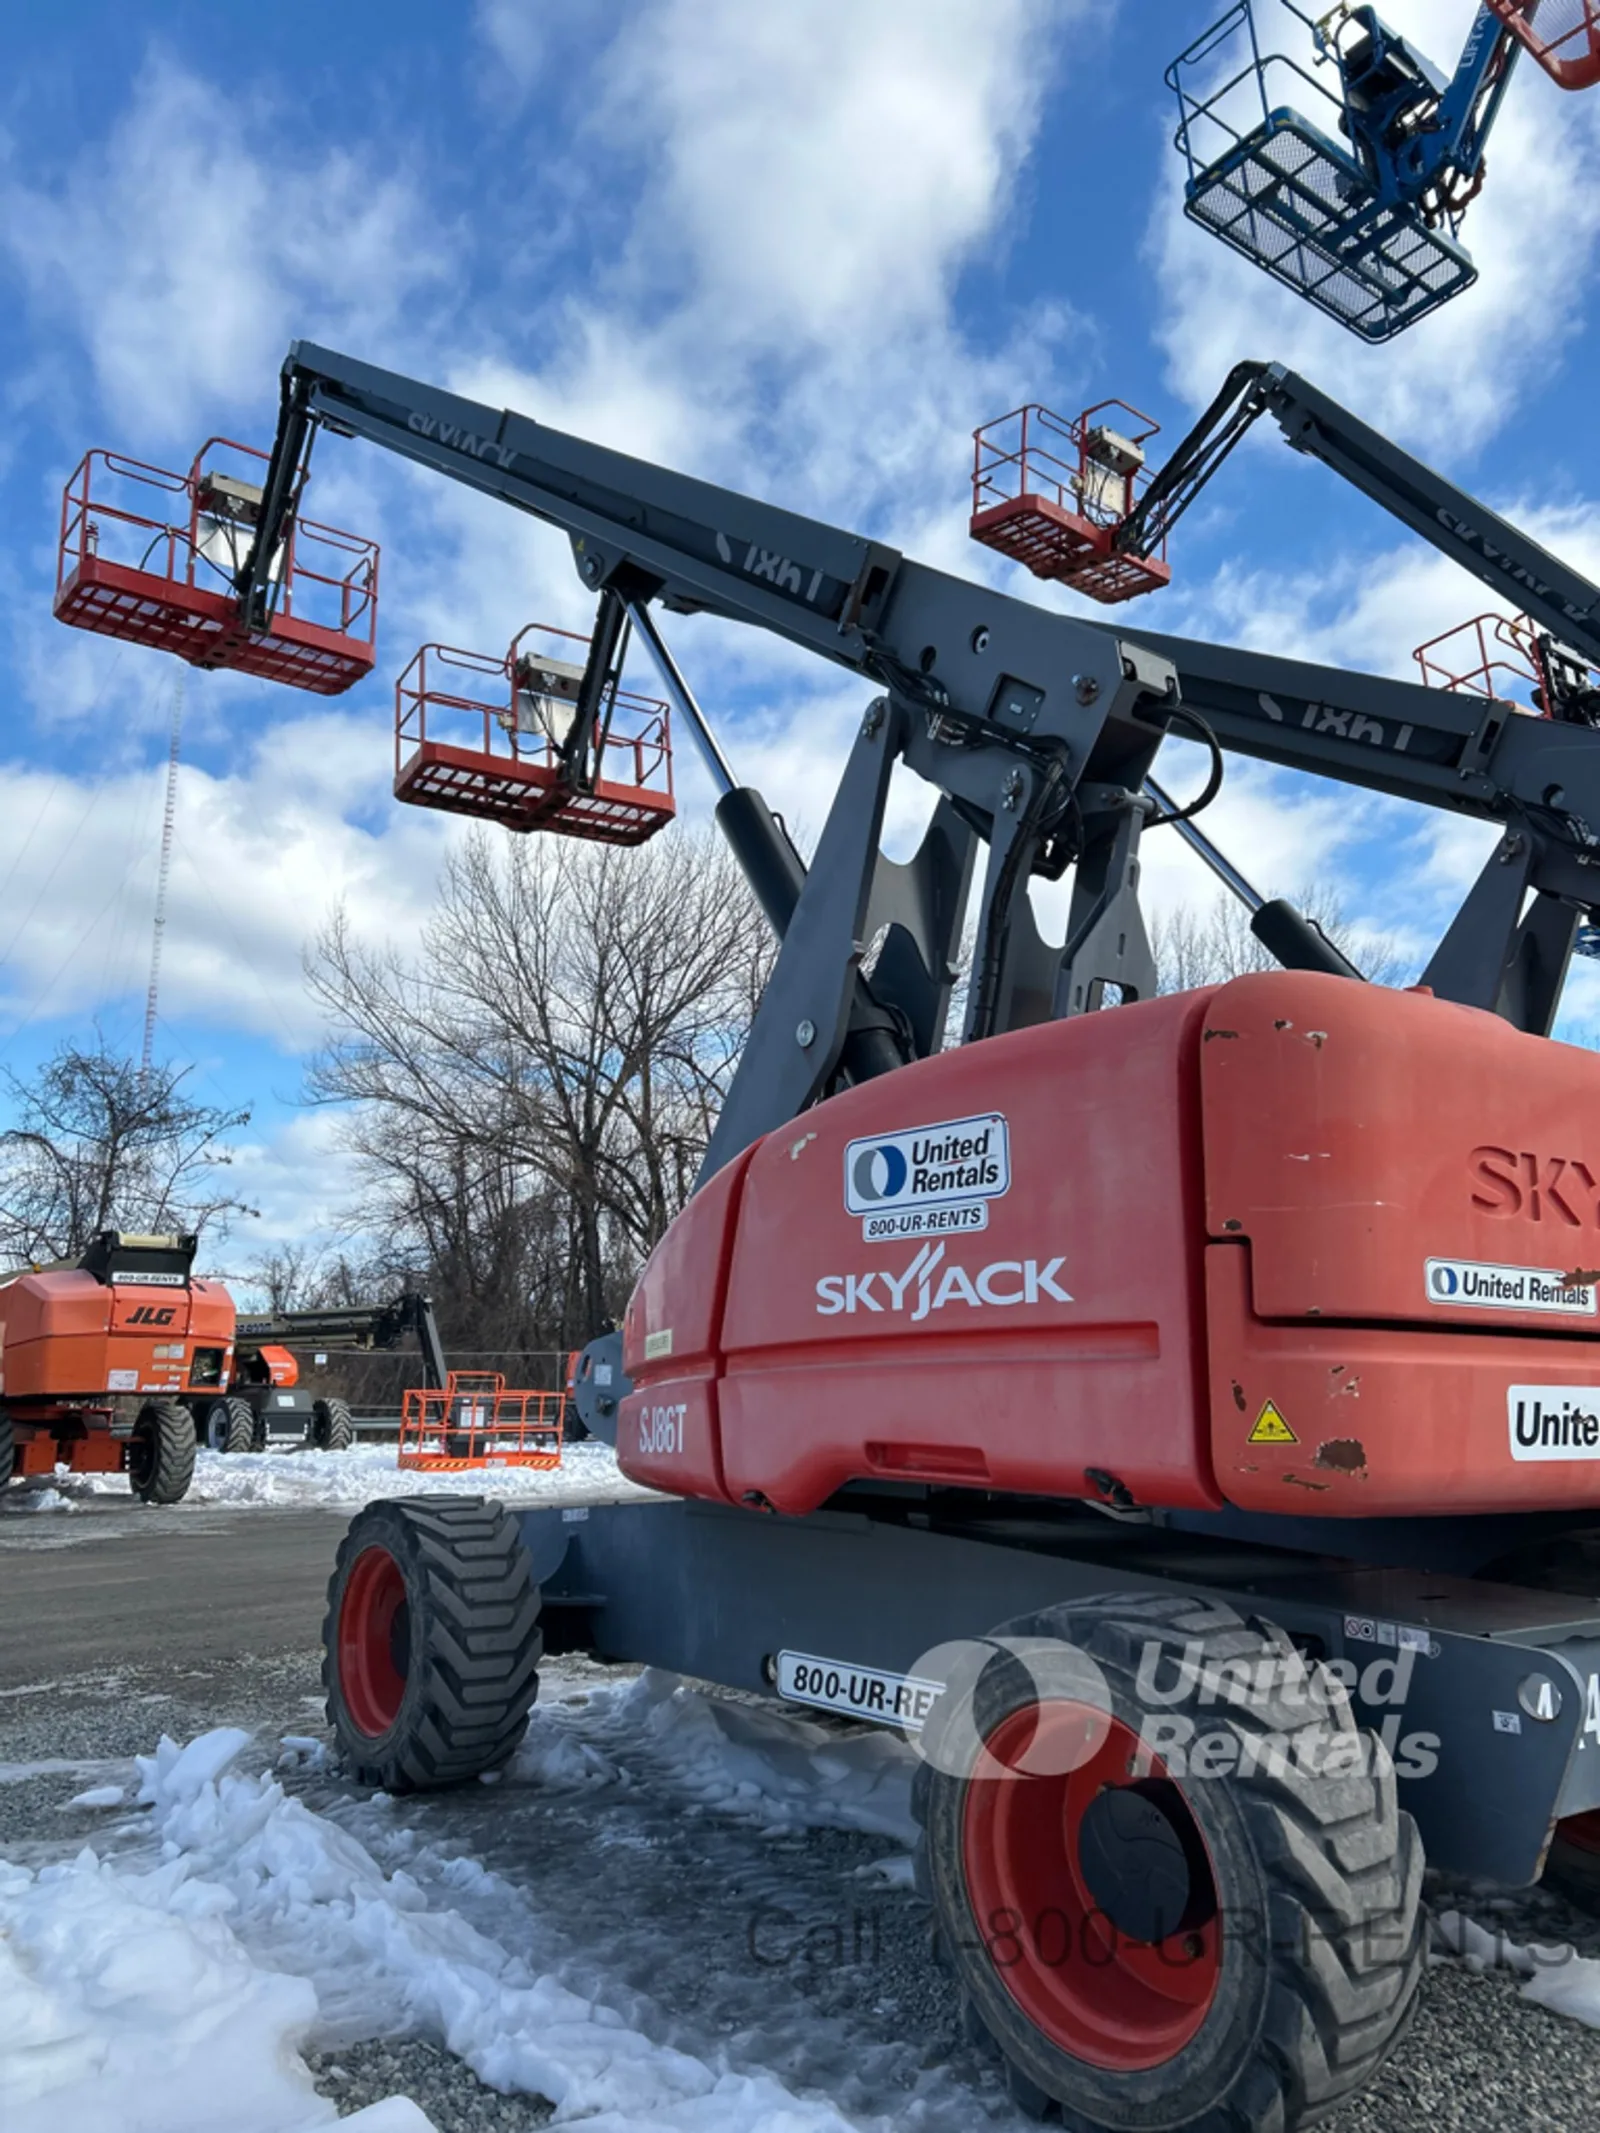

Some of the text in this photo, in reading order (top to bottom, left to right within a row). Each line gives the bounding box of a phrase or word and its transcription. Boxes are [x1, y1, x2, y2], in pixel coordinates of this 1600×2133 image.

[912, 1128, 990, 1165] United
[912, 1159, 999, 1194] Rentals
[868, 1207, 981, 1236] 800-UR-RENTS
[816, 1240, 1075, 1321] SKYJACK
[1463, 1270, 1525, 1300] United
[125, 1306, 177, 1326] JLG
[639, 1404, 687, 1453] SJ86T
[1516, 1401, 1600, 1447] Unite
[793, 1664, 944, 1719] 800-UR-RE
